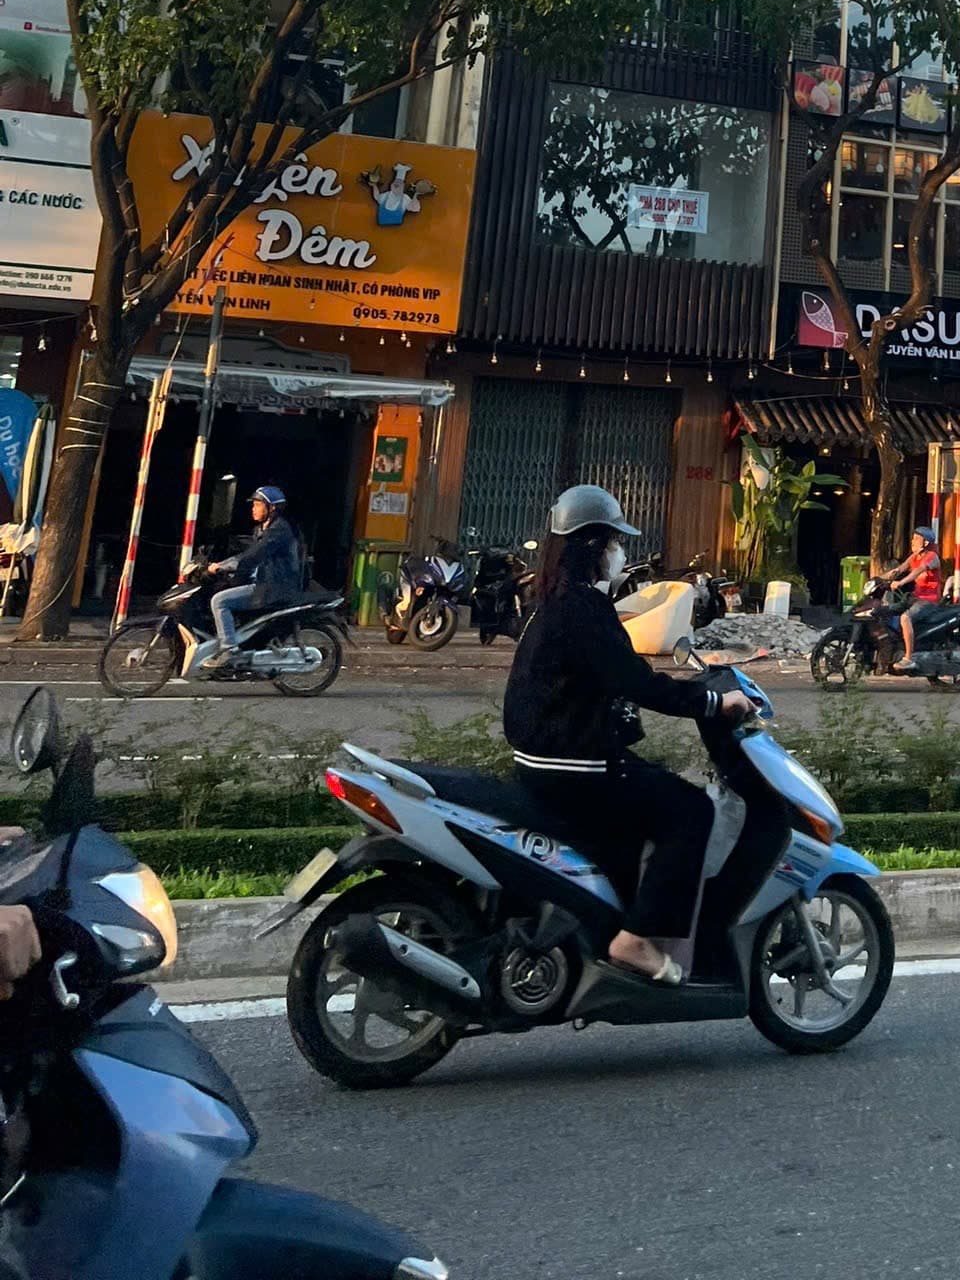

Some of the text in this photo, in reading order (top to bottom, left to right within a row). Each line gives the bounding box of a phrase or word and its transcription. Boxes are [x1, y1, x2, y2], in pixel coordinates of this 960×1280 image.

[8, 188, 38, 206] CÁC
[42, 192, 83, 211] NƯỚC
[255, 208, 378, 269] Đêm
[230, 269, 257, 285] LIÊN
[258, 273, 291, 287] HOAN
[294, 276, 323, 291] SINH
[362, 280, 379, 296] CÓ
[380, 282, 420, 300] PHÒNG
[422, 287, 441, 301] VIP
[240, 298, 271, 311] LINH
[925, 344, 948, 360] VĂN
